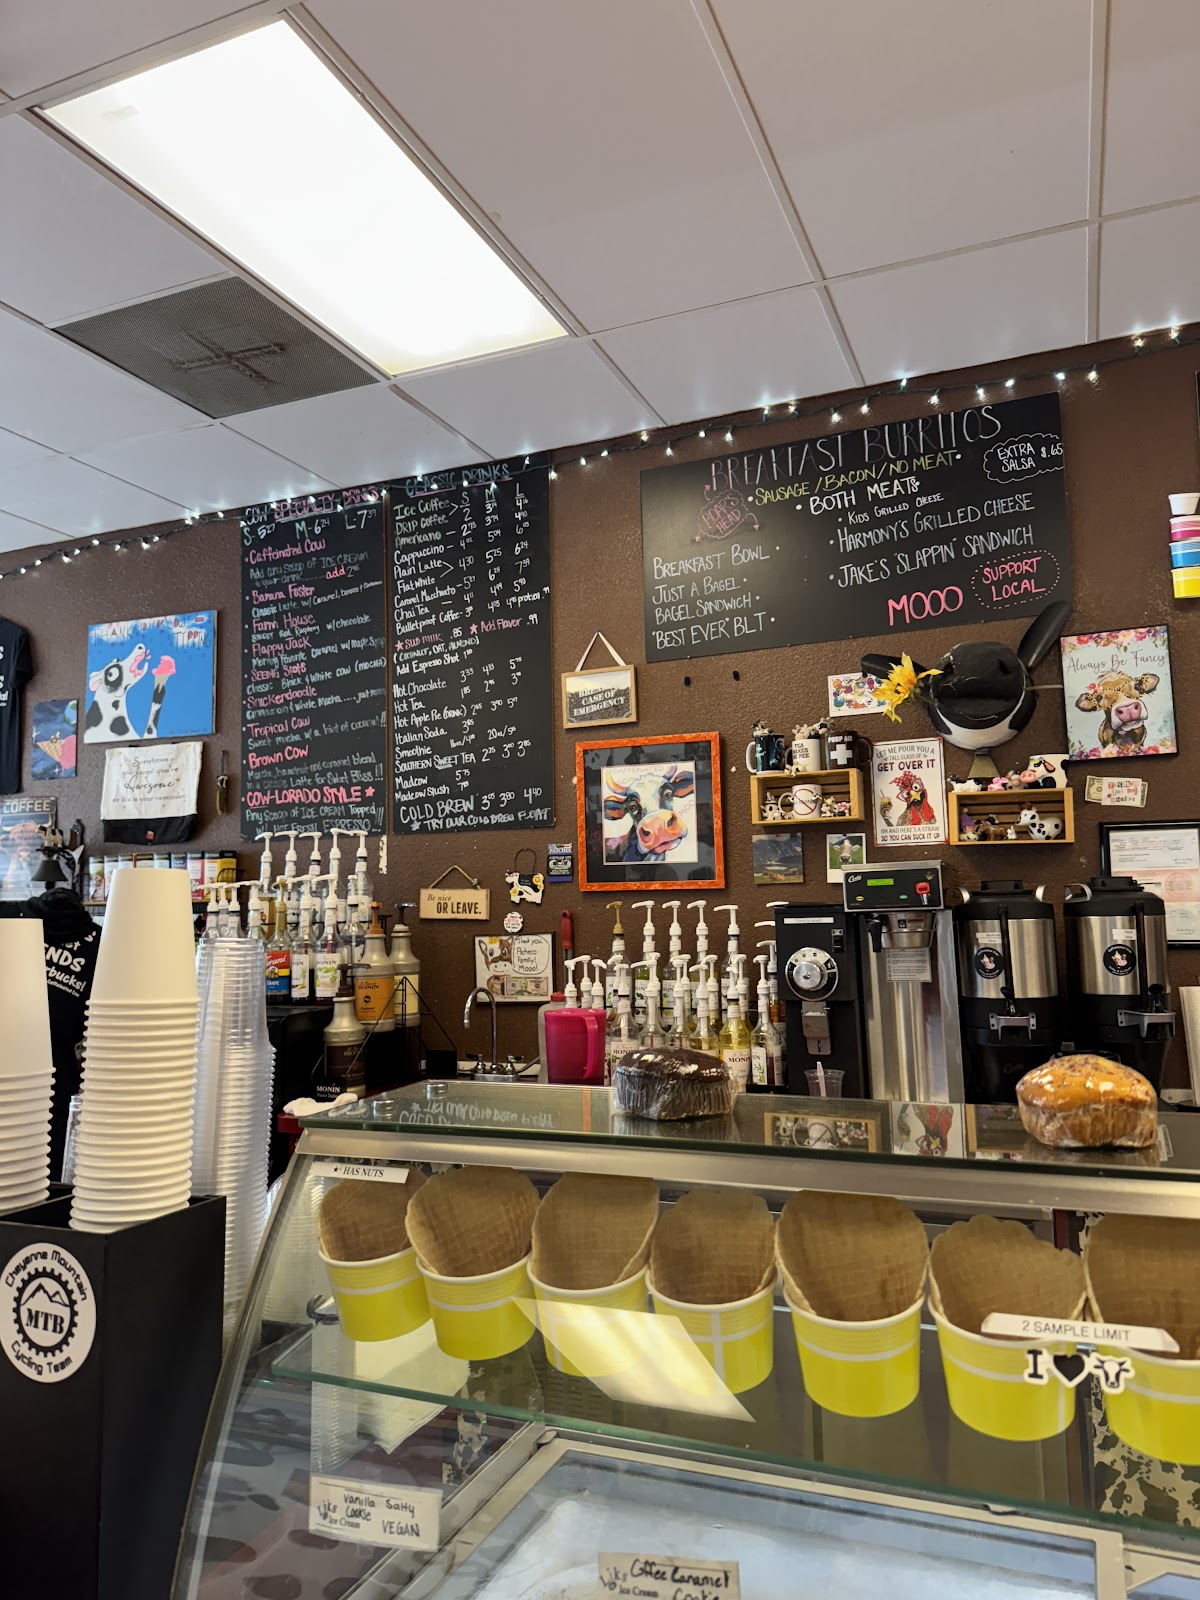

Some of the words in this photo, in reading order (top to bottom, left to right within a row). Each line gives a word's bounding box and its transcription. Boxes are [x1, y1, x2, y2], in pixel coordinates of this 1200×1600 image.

[711, 433, 846, 491] BREAKFAST
[864, 405, 1001, 463] BURRITOS
[997, 442, 1035, 461] EXTRA
[913, 450, 957, 471] MEAT
[1001, 456, 1036, 473] SALSA
[809, 490, 856, 515] BOTH
[866, 476, 918, 501] MEATS
[874, 502, 909, 517] GRILLED
[916, 493, 944, 508] CHEESE
[395, 520, 418, 535] DRIP
[716, 509, 742, 535] HEAD
[838, 520, 910, 552] HARMONY'S
[914, 506, 981, 534] GRILLED
[983, 493, 1035, 518] CHEESE
[395, 531, 442, 549] Americano
[394, 544, 445, 565] Cappuccino
[653, 552, 725, 580] BREAKFAST
[731, 543, 770, 566] BOWL
[838, 558, 891, 587] JAKE'S
[962, 525, 1034, 558] SANDWICH
[394, 566, 416, 580] Plain
[418, 558, 443, 573] Latte
[981, 556, 1041, 584] SUPPORT
[251, 589, 286, 605] Banana
[288, 583, 316, 599] Foster
[652, 584, 686, 604] JUST
[690, 582, 700, 597] A
[703, 576, 741, 595] BAGEL
[991, 579, 1046, 602] LOCAL
[394, 608, 416, 622] Chai
[416, 603, 430, 615] Tea
[655, 604, 695, 625] BAGEL
[696, 592, 751, 617] SANDWICH
[887, 585, 964, 626] MOOO
[252, 618, 279, 633] Farm
[283, 613, 316, 629] House
[395, 614, 437, 635] Bulletproof
[733, 611, 767, 637] BLT
[251, 641, 284, 658] Flappy
[396, 663, 410, 676] Add
[412, 657, 442, 674] Espresso
[443, 651, 460, 666] Shot
[1066, 656, 1106, 675] Always
[1110, 653, 1127, 670] Be
[1131, 650, 1167, 667] Fancy
[393, 683, 408, 698] Hot
[408, 678, 448, 695] Chocolate
[581, 692, 604, 706] CASE
[604, 689, 616, 699] OF
[393, 701, 409, 714] Hot
[409, 697, 426, 709] Tea
[573, 696, 626, 716] EMERGENCY
[247, 720, 289, 739] Tropical
[290, 716, 311, 730] Cow
[393, 715, 409, 730] Hot
[410, 711, 430, 728] Apple
[394, 731, 424, 745] Italian
[423, 726, 448, 740] Soda
[248, 752, 284, 769] Brown
[284, 744, 309, 760] Cow
[394, 745, 433, 760] Smoothie
[876, 750, 886, 758] LET
[898, 745, 915, 753] POUR
[916, 745, 929, 753] YOU
[394, 759, 433, 774] SOUTHERN
[433, 754, 459, 768] SWEET
[460, 752, 477, 764] TEA
[877, 762, 894, 772] GET
[898, 760, 923, 770] OVER
[927, 759, 935, 768] IT
[124, 775, 175, 794] Awesome
[394, 775, 428, 790] Madcow
[3, 800, 51, 814] COFFEE
[246, 788, 321, 808] COW-LORADO
[322, 785, 362, 804] STYLE
[290, 807, 300, 818] of
[348, 802, 376, 816] Topped
[400, 804, 434, 824] COLD
[437, 795, 475, 817] BREW
[437, 902, 448, 914] OR
[451, 901, 482, 914] LEAVE.
[516, 947, 537, 955] Pacheco
[343, 1166, 361, 1176] HAS
[362, 1167, 385, 1178] NUTS
[5, 1251, 48, 1287] Cheyenne
[51, 1249, 87, 1301] Mountain
[25, 1308, 65, 1334] MTB
[1022, 1320, 1030, 1331] 2
[1034, 1321, 1089, 1338] SAMPLE
[1094, 1327, 1131, 1341] LIMIT
[11, 1340, 43, 1376] Cycling
[46, 1356, 73, 1374] Team
[345, 1507, 372, 1521] Cookie
[382, 1520, 420, 1537] VEGAN
[630, 1558, 667, 1581] Coffee
[671, 1566, 729, 1588] Caramel
[619, 1585, 630, 1594] Ice
